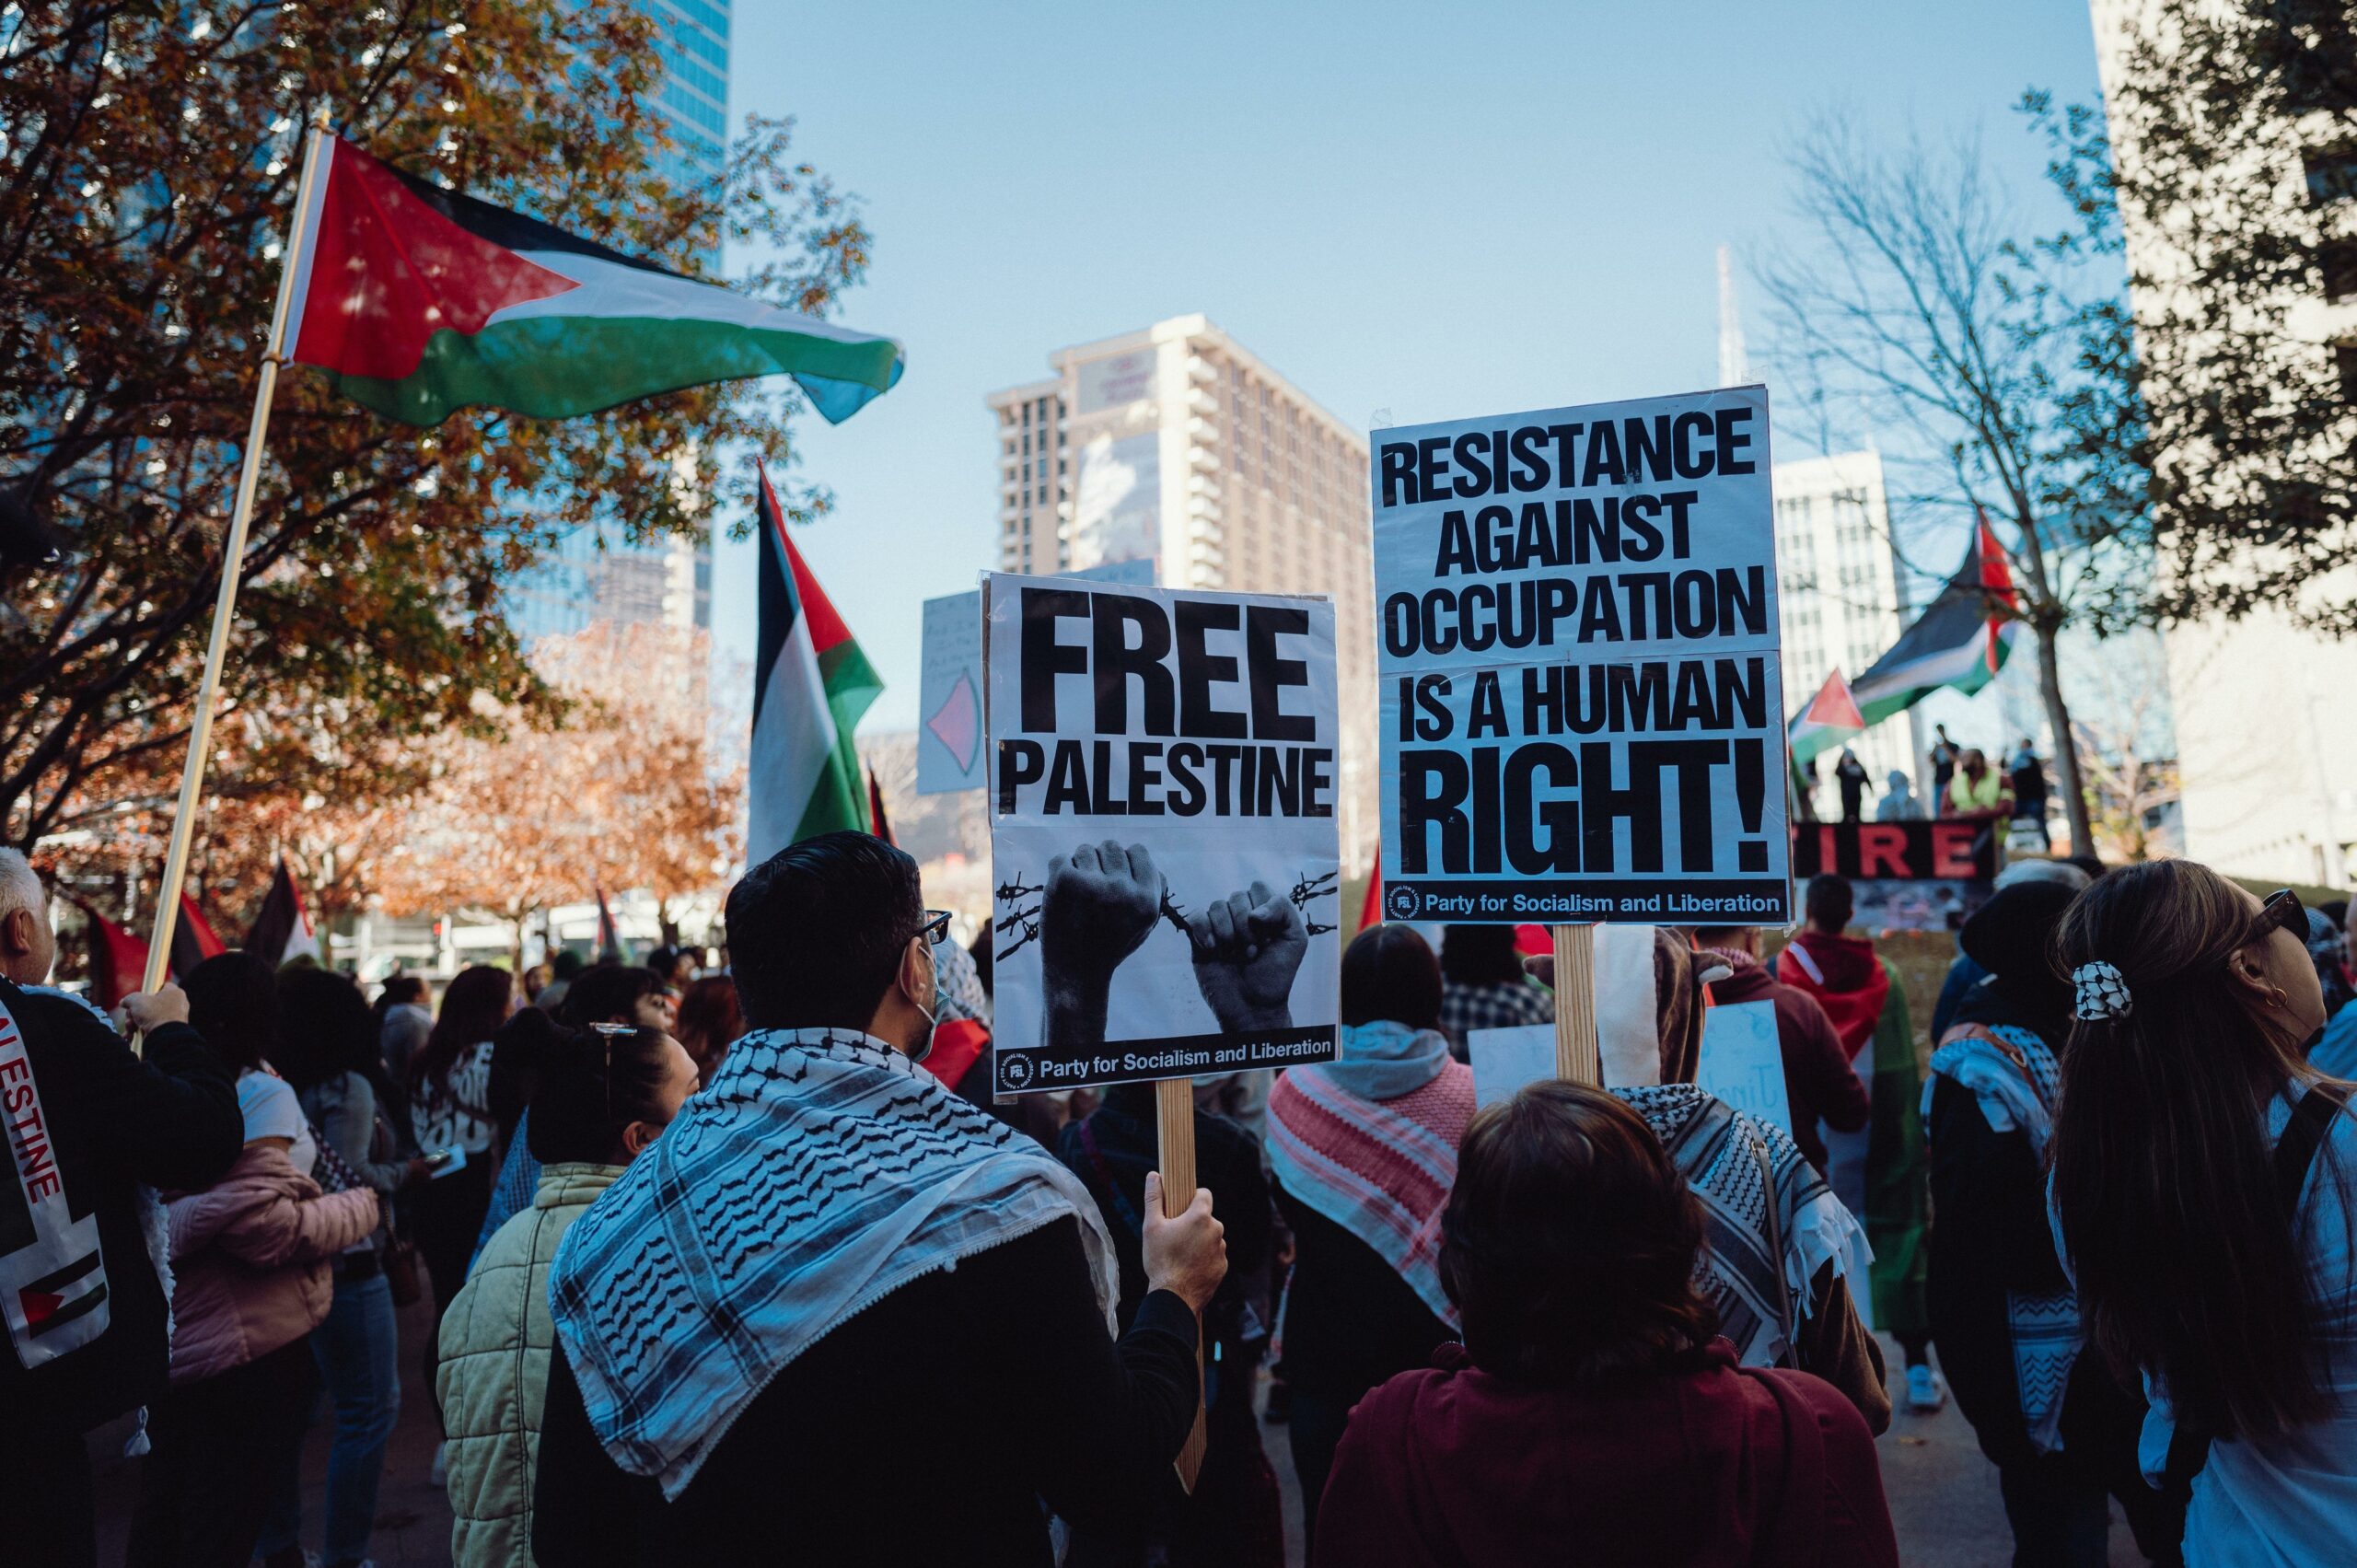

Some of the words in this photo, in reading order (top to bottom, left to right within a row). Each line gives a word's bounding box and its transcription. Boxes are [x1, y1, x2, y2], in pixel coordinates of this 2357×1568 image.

[1381, 408, 1755, 507] RESISTANCE
[1434, 491, 1698, 577] AGAINST
[1384, 565, 1768, 657] OCCUPATION
[1021, 587, 1317, 742] FREE
[1399, 674, 1455, 742] IS
[1467, 670, 1509, 739] A
[1523, 657, 1767, 736] HUMAN
[998, 739, 1333, 818] PALESTINE
[1399, 738, 1770, 876] RIGHT!
[1425, 894, 1475, 914] Party
[1480, 894, 1508, 912] for
[1513, 893, 1614, 912] Socialism
[1620, 893, 1661, 912] and
[1667, 893, 1780, 912] Liberation
[1010, 1065, 1025, 1078] PSL
[1040, 1060, 1089, 1078] Party
[1094, 1056, 1119, 1074] for
[1124, 1050, 1210, 1071] Socialism
[1214, 1044, 1247, 1063] and
[1251, 1039, 1331, 1059] Liberation
